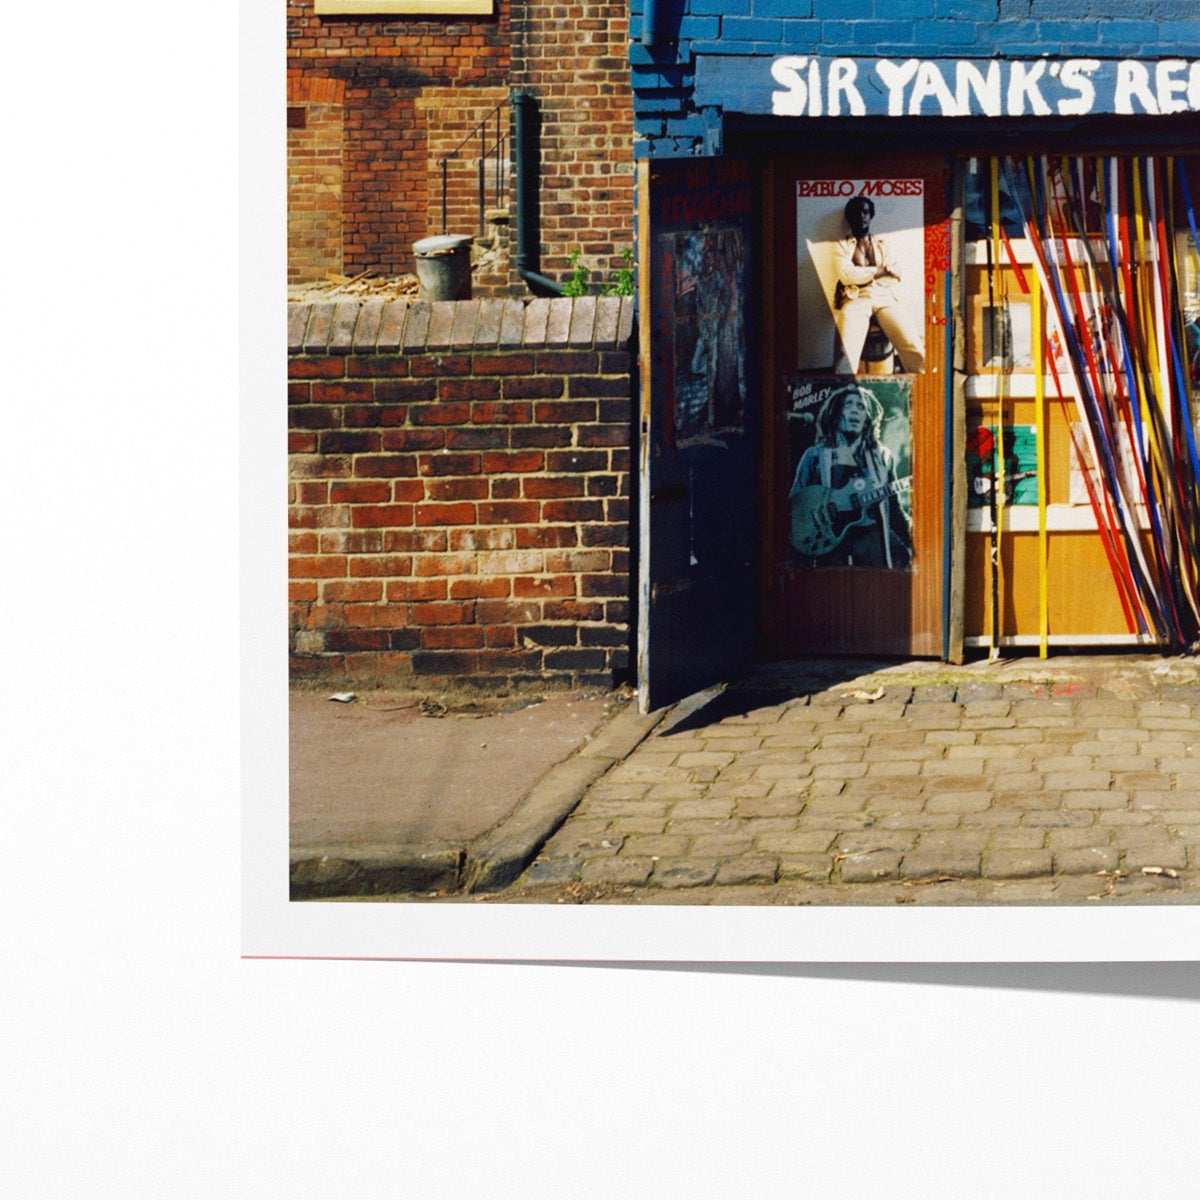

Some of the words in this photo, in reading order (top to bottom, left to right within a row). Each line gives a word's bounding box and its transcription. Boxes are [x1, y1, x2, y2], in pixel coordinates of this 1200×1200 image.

[770, 55, 866, 117] SIR
[875, 57, 1101, 117] YANK'S
[798, 180, 855, 197] PABLO
[858, 180, 923, 197] MOSES
[792, 383, 813, 400] BOB
[793, 386, 832, 412] MARLEY
